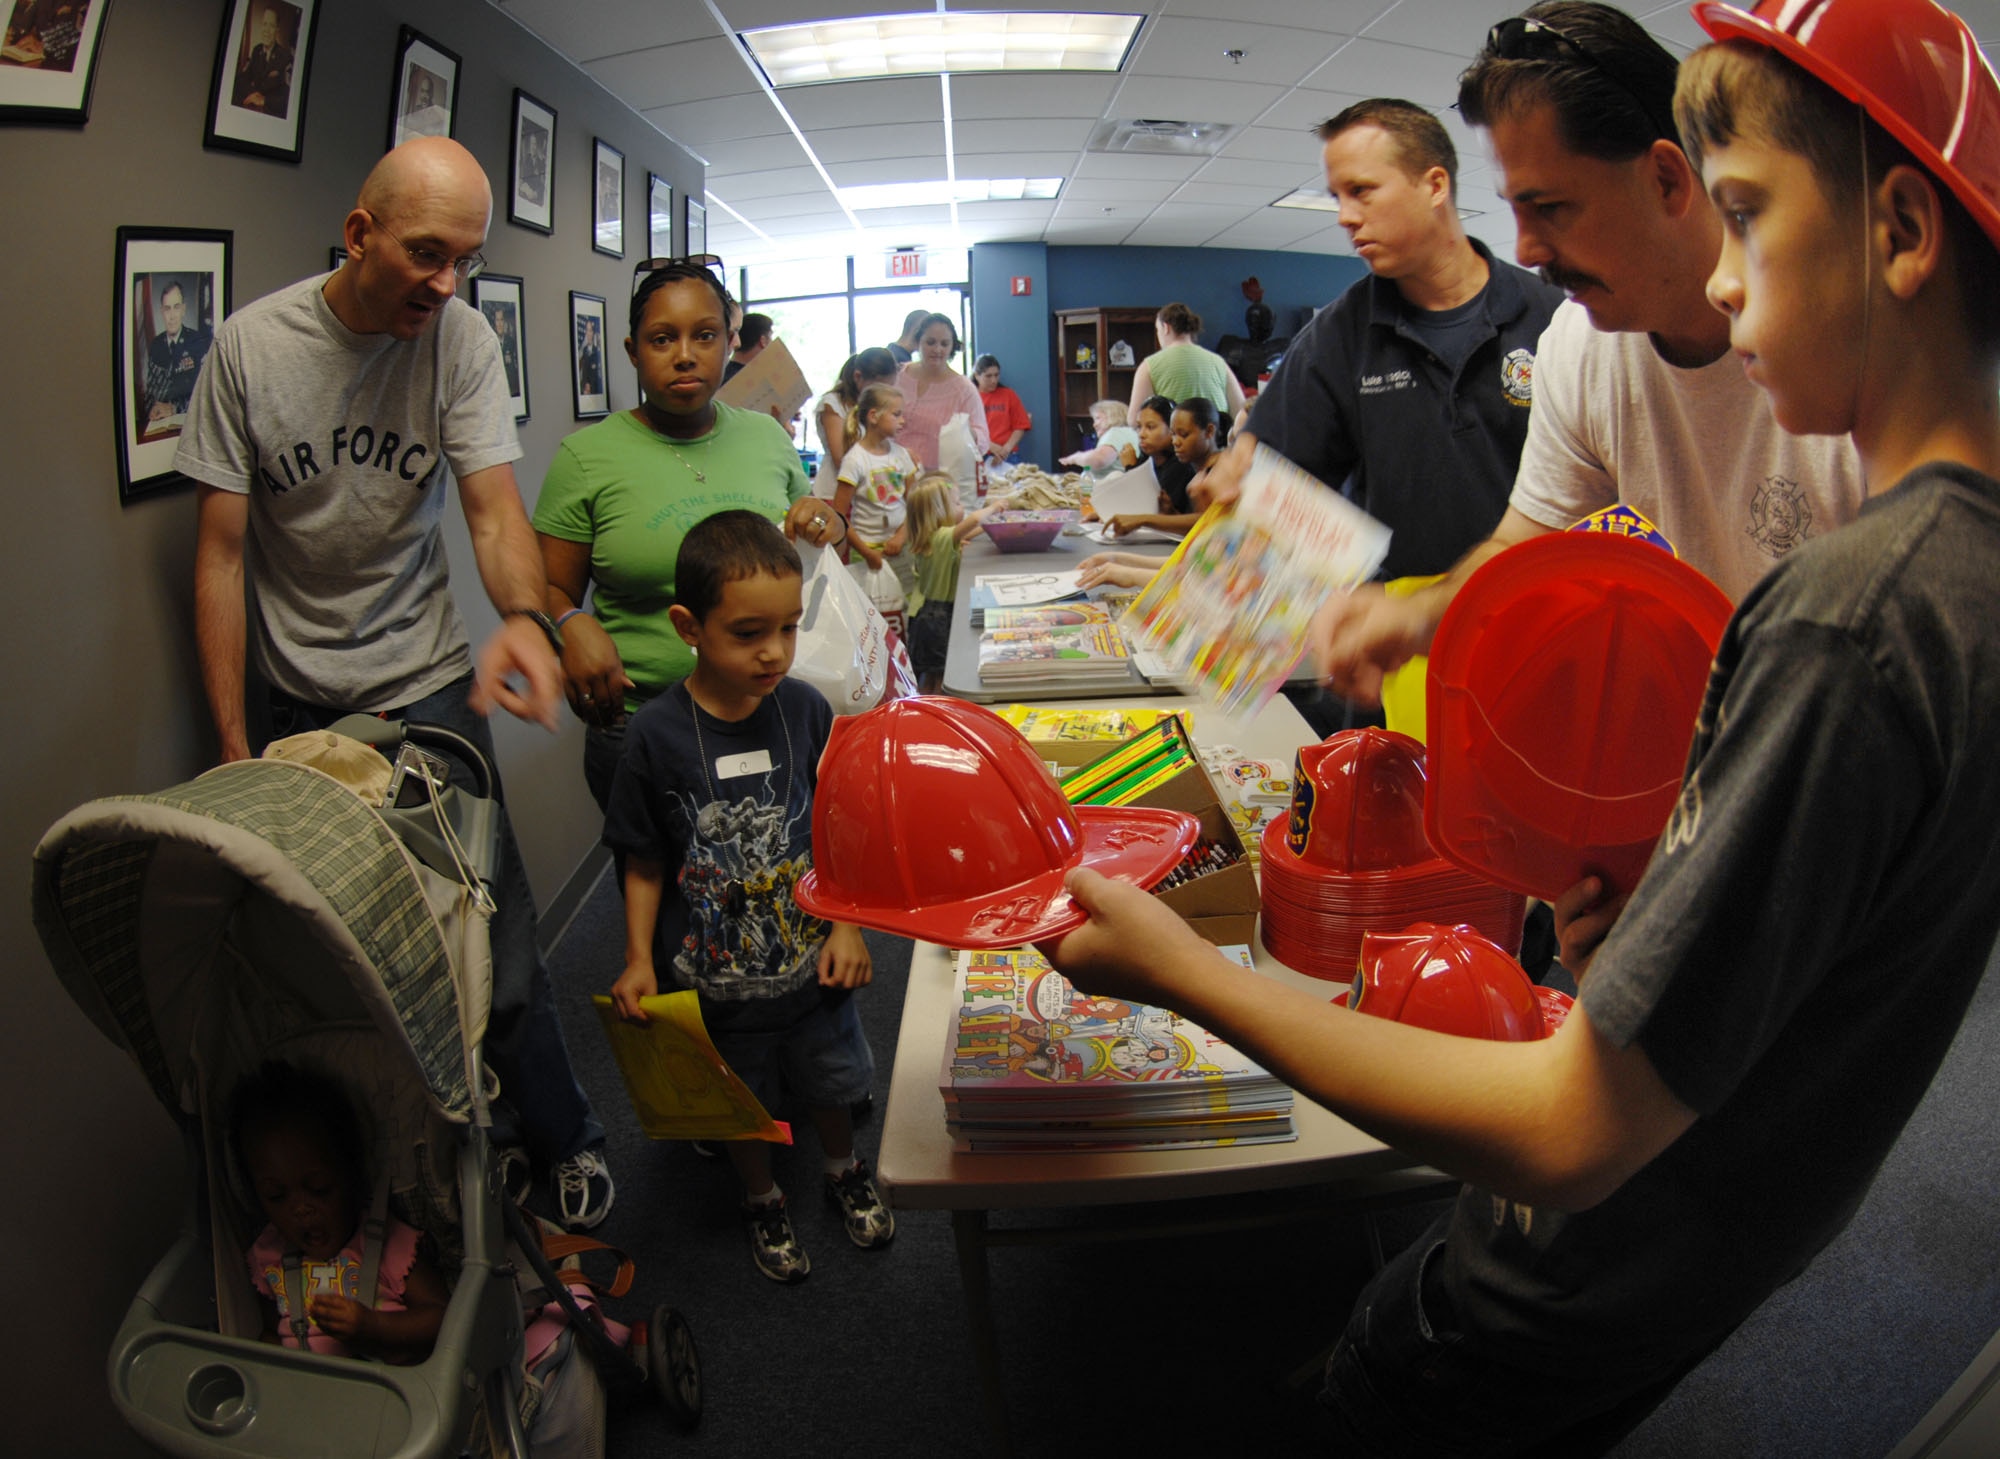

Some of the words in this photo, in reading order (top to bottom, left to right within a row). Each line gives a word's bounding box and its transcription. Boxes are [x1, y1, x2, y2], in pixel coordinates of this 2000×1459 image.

[892, 254, 920, 276] EXIT
[260, 441, 321, 496] AIR
[645, 503, 680, 531] SHUT
[681, 496, 708, 508] THE
[711, 492, 756, 505] SHELL
[851, 646, 878, 702] CONITY
[963, 964, 1016, 1002] FIRE
[953, 1004, 1013, 1070] SAFETY
